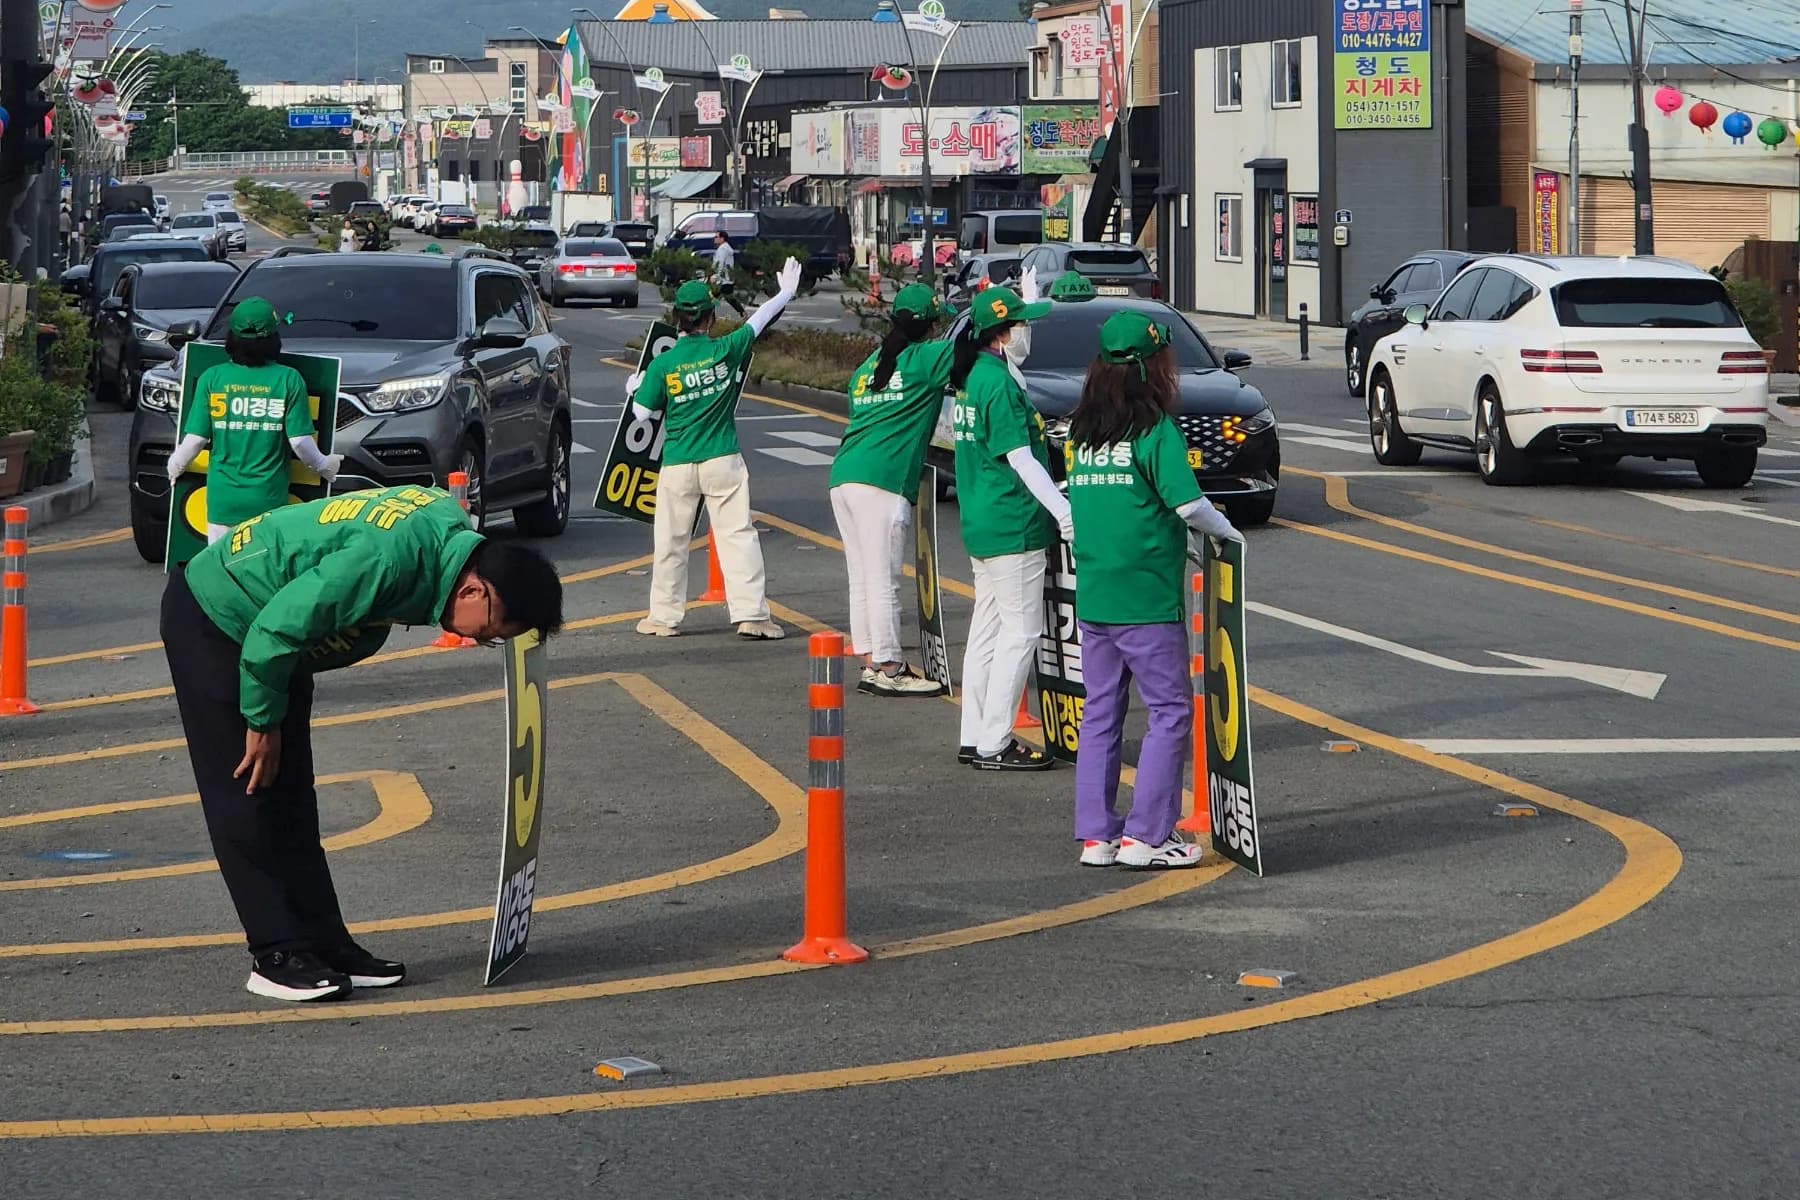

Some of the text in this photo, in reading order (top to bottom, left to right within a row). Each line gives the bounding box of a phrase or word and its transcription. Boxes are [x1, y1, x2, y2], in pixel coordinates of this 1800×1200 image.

[1341, 11, 1423, 32] 도장/고무인
[1342, 32, 1422, 48] 010-4476-4427
[1070, 50, 1095, 63] 청도
[1345, 77, 1423, 98] 지게차
[1346, 100, 1420, 113] 054)371-1517
[1346, 114, 1420, 124] 010-3450-4456
[1061, 283, 1091, 294] TAXI
[991, 299, 1008, 319] 5
[665, 372, 683, 396] 5
[685, 361, 729, 389] 이경동
[853, 373, 868, 397] 5
[210, 393, 286, 418] 5 이경동
[1667, 411, 1696, 424] 5823
[1064, 440, 1075, 472] 5
[1209, 558, 1239, 762] 5
[513, 627, 542, 848] 5
[1210, 771, 1255, 859] 이경동
